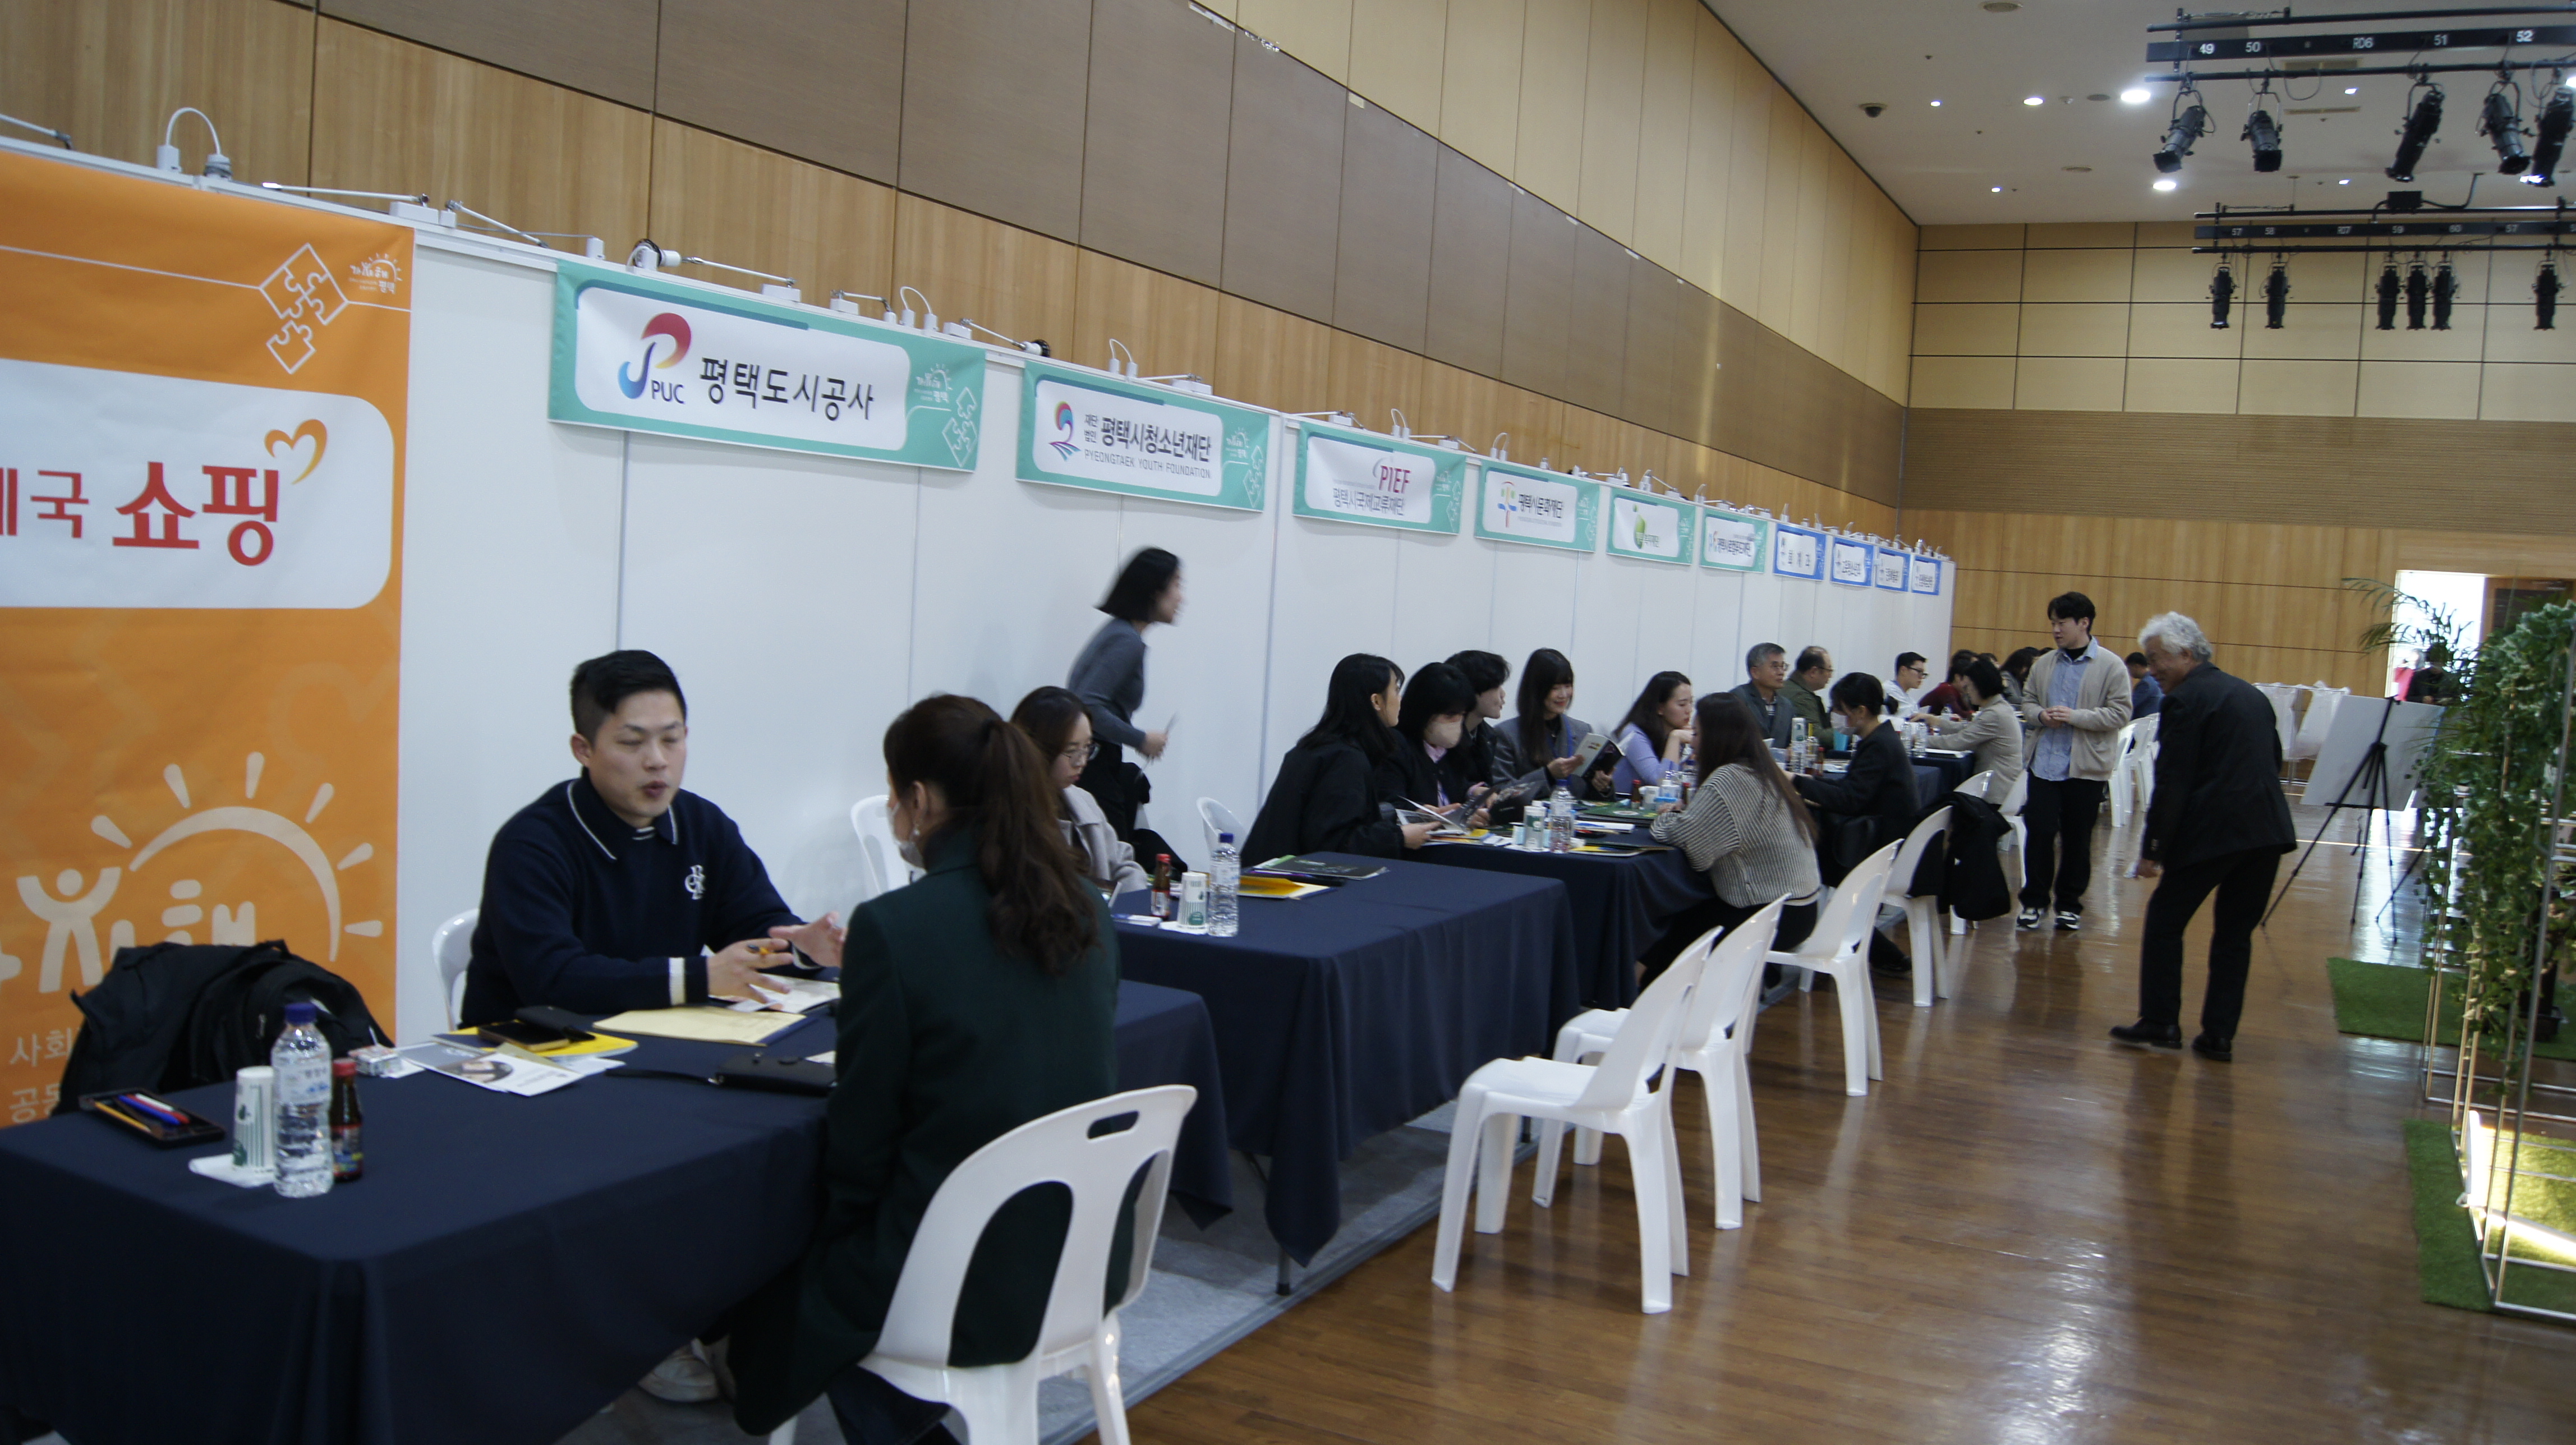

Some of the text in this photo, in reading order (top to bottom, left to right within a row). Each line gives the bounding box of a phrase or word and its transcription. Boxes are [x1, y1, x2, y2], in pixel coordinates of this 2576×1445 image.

[2198, 43, 2215, 54] 49
[2245, 42, 2261, 53] 50
[2433, 34, 2449, 46] 51
[2516, 29, 2534, 43] 52
[651, 379, 686, 404] PUC
[699, 357, 875, 422] 평택도시공사
[1101, 417, 1211, 462] 평택시청소년재단
[1084, 448, 1211, 479] PYEONGTAEK YOUTH FOUNDATION
[1378, 465, 1411, 495] PIEF
[112, 461, 279, 566] 쇼핑
[8, 1027, 80, 1067] 사회
